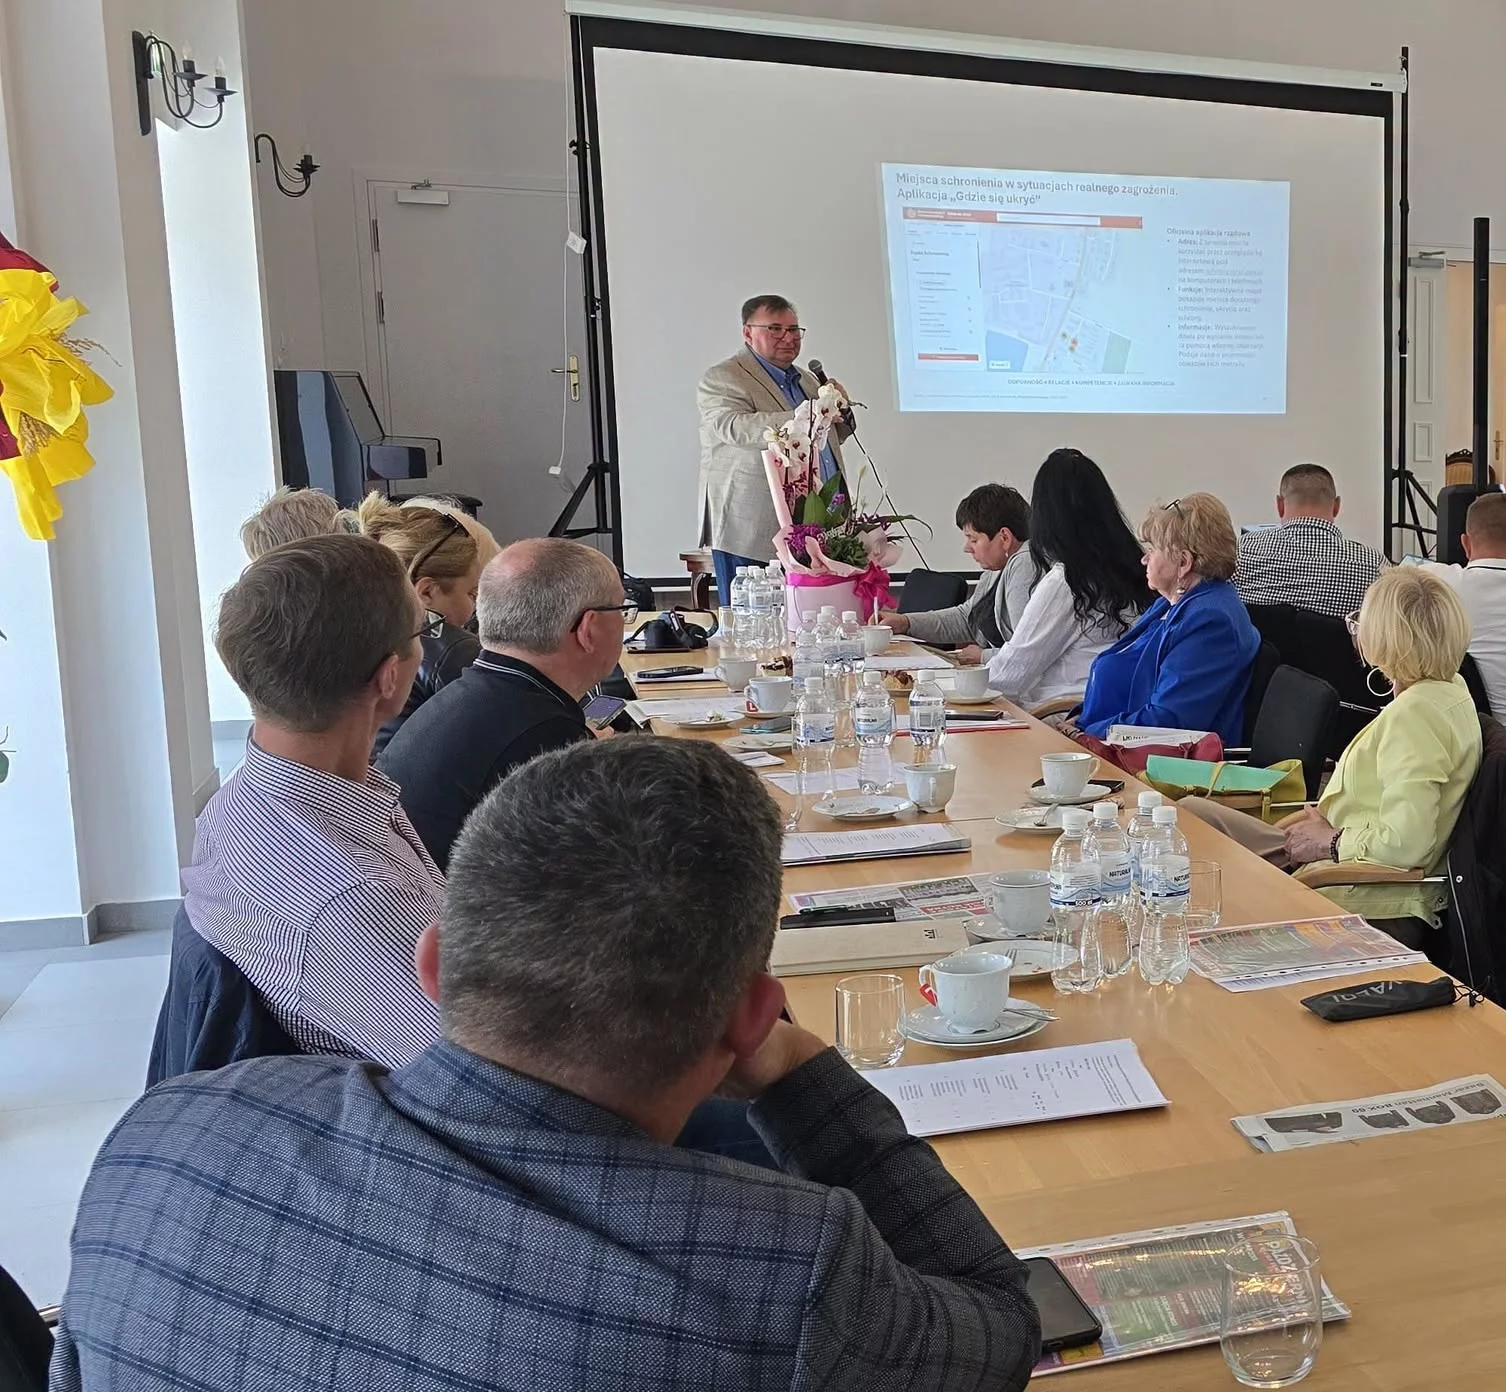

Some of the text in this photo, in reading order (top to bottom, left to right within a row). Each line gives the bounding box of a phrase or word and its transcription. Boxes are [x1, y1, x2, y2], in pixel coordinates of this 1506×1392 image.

[896, 172, 938, 186] Miejsca
[941, 176, 1003, 188] schronienia
[1005, 180, 1015, 188] w
[1017, 180, 1074, 192] sytuacjach
[1075, 182, 1120, 195] realnego
[897, 188, 948, 202] Aplikacja
[988, 193, 1005, 205] się
